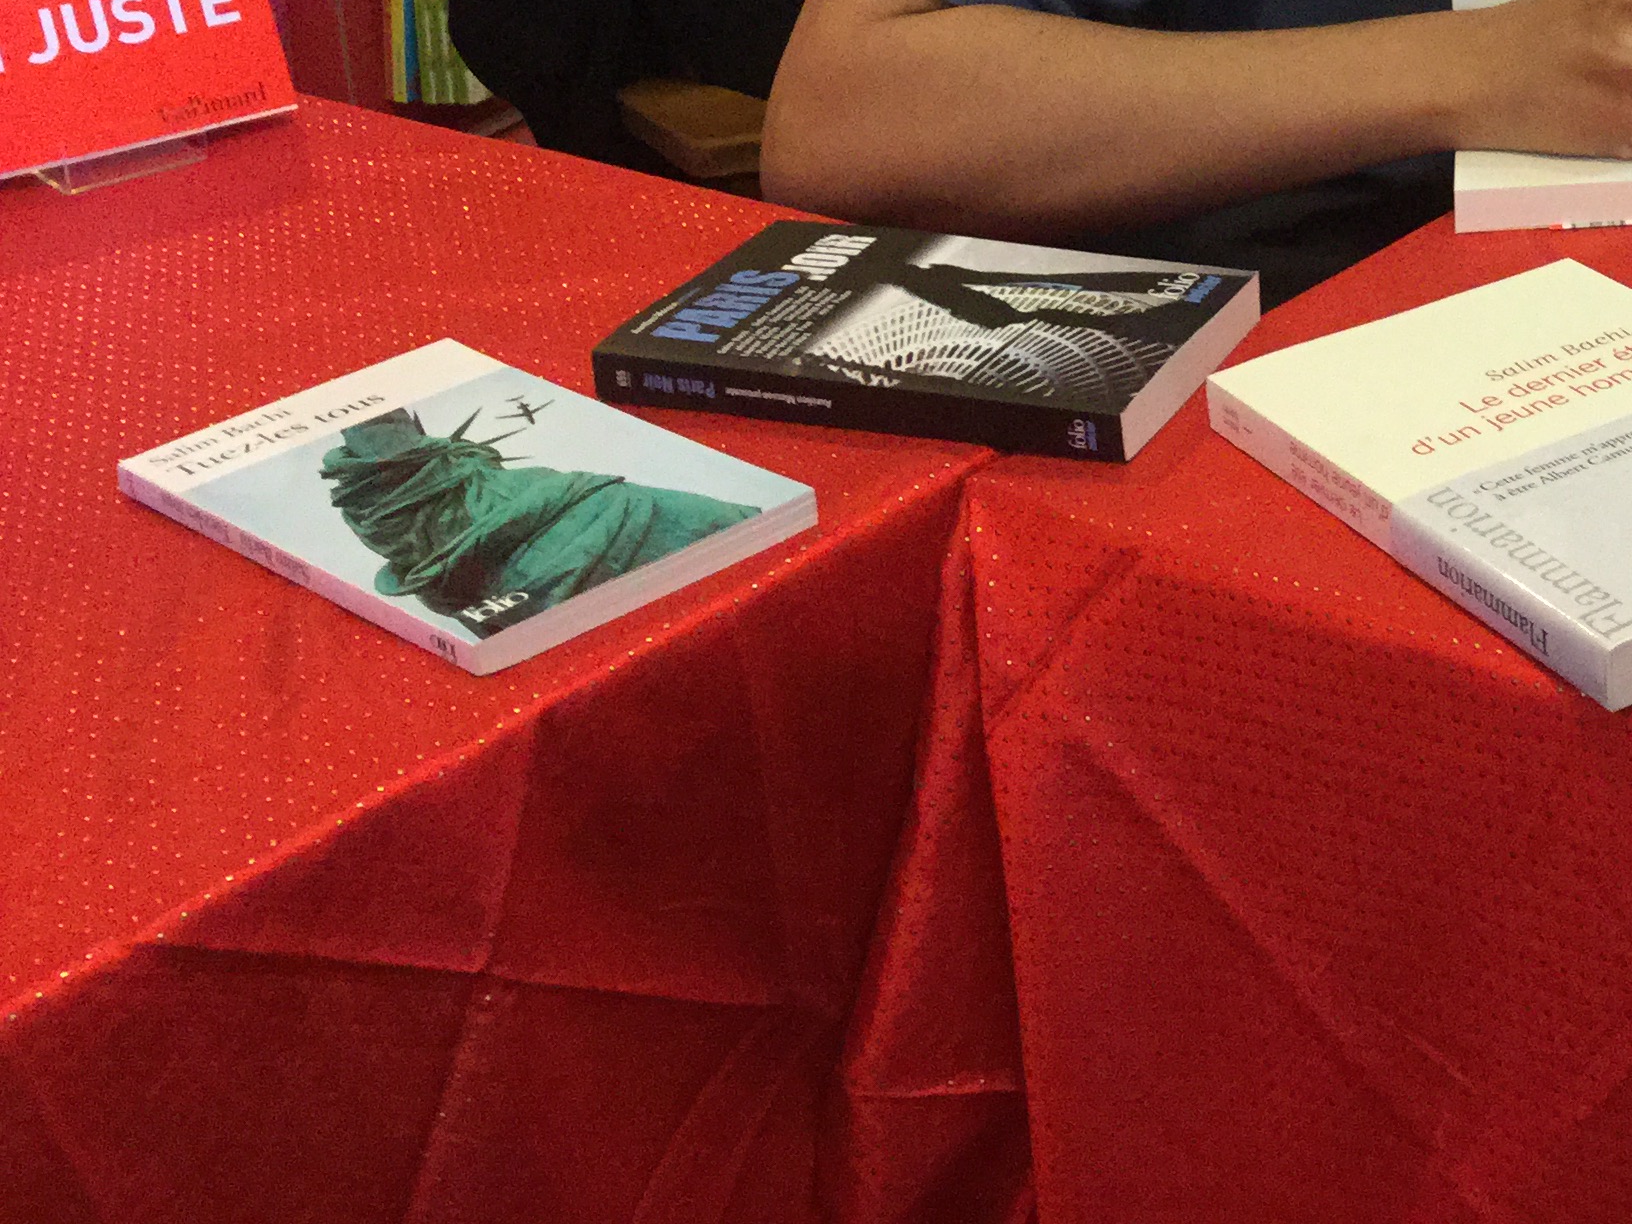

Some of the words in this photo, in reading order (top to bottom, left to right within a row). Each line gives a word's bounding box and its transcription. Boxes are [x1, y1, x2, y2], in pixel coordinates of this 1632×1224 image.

[1148, 272, 1200, 300] folio
[651, 269, 800, 344] PARIS
[1459, 394, 1503, 414] Le
[1507, 356, 1608, 399] dernier
[1485, 352, 1559, 382] Salim
[677, 376, 716, 399] Paris
[150, 436, 218, 466] Salim
[222, 407, 292, 438] Bachi
[165, 423, 309, 476] Tuez-les
[315, 394, 386, 423] tous
[1068, 418, 1086, 451] folio
[1411, 424, 1482, 456] d'un
[1481, 393, 1570, 432] jeune
[1494, 492, 1507, 502] à
[1507, 481, 1537, 498] être
[1539, 462, 1589, 486] Albert
[1524, 451, 1581, 477] femme
[462, 592, 529, 623] folio
[1437, 557, 1550, 657] Flammarion
